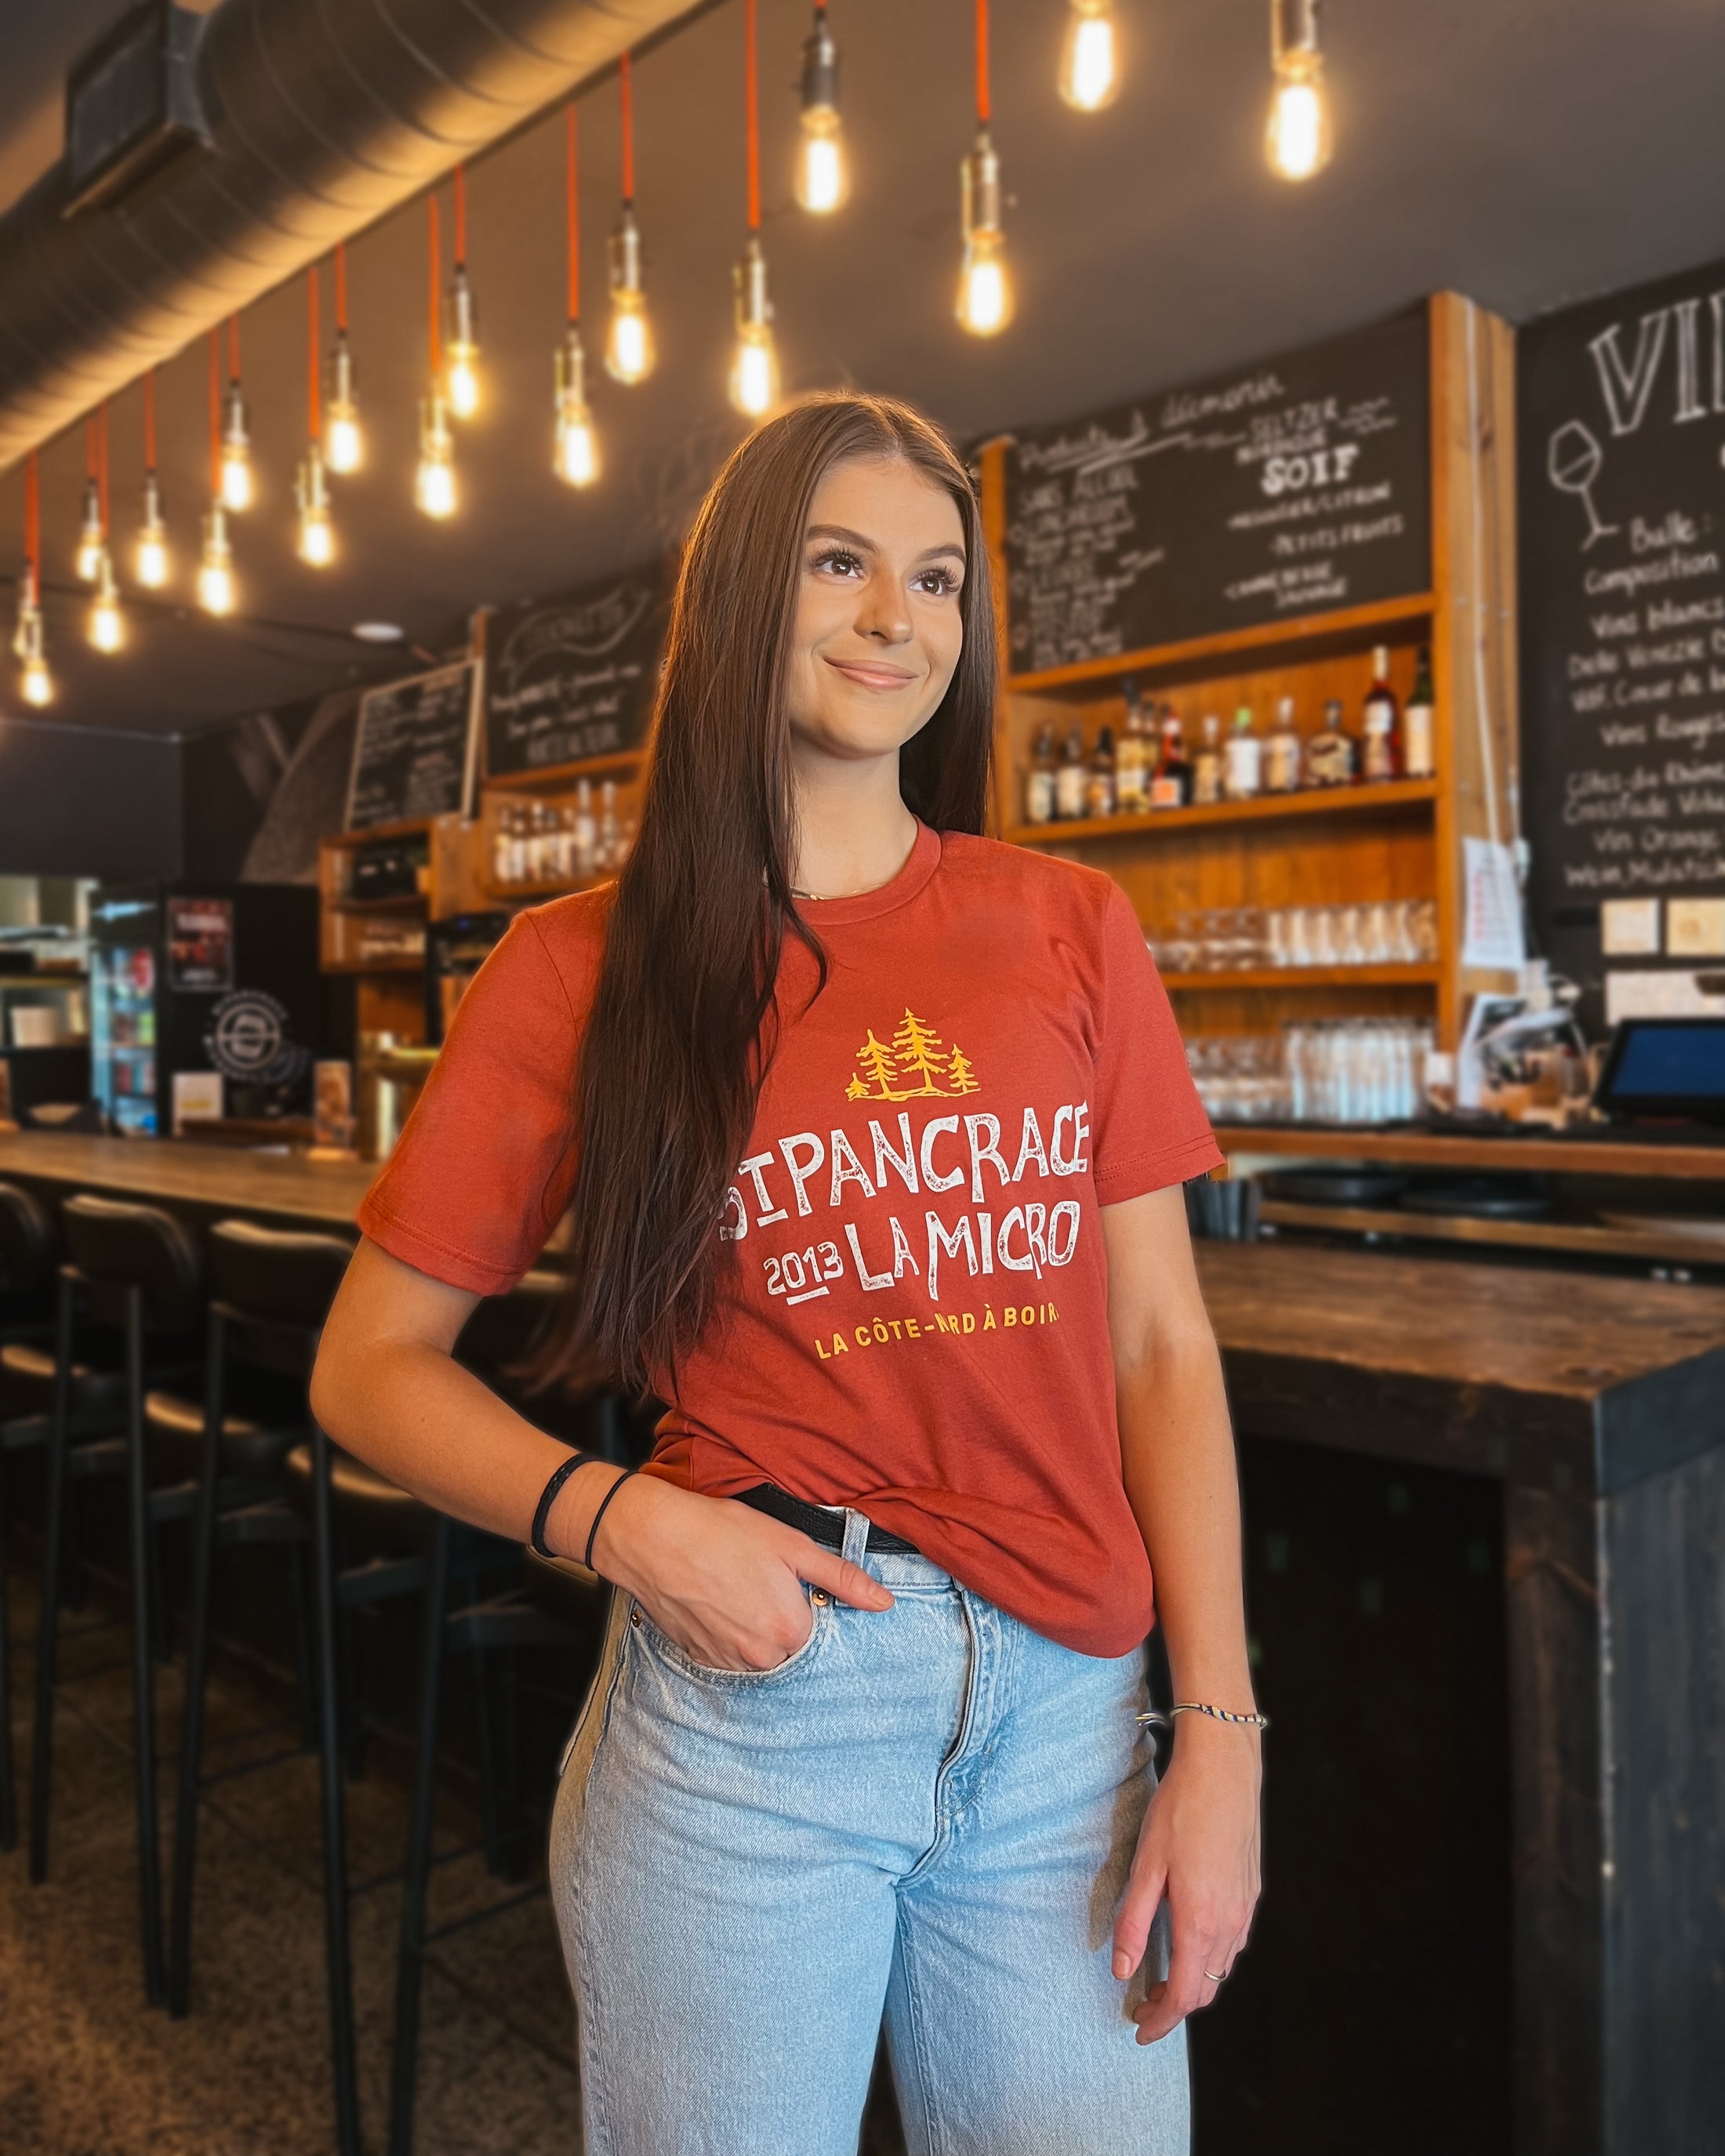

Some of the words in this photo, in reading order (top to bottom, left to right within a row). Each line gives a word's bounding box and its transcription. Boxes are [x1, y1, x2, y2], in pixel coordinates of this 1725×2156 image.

[1261, 442, 1360, 498] SOIF
[1584, 547, 1720, 598] Composition
[778, 1099, 1090, 1218] PANCRACE
[762, 1241, 844, 1298] 2013
[844, 1216, 921, 1292] LA
[924, 1200, 1081, 1301] MICRO
[814, 1332, 850, 1359] LA
[854, 1312, 976, 1347] CÔTE-NRD
[982, 1302, 997, 1331] À
[1003, 1301, 1060, 1328] BOIR
